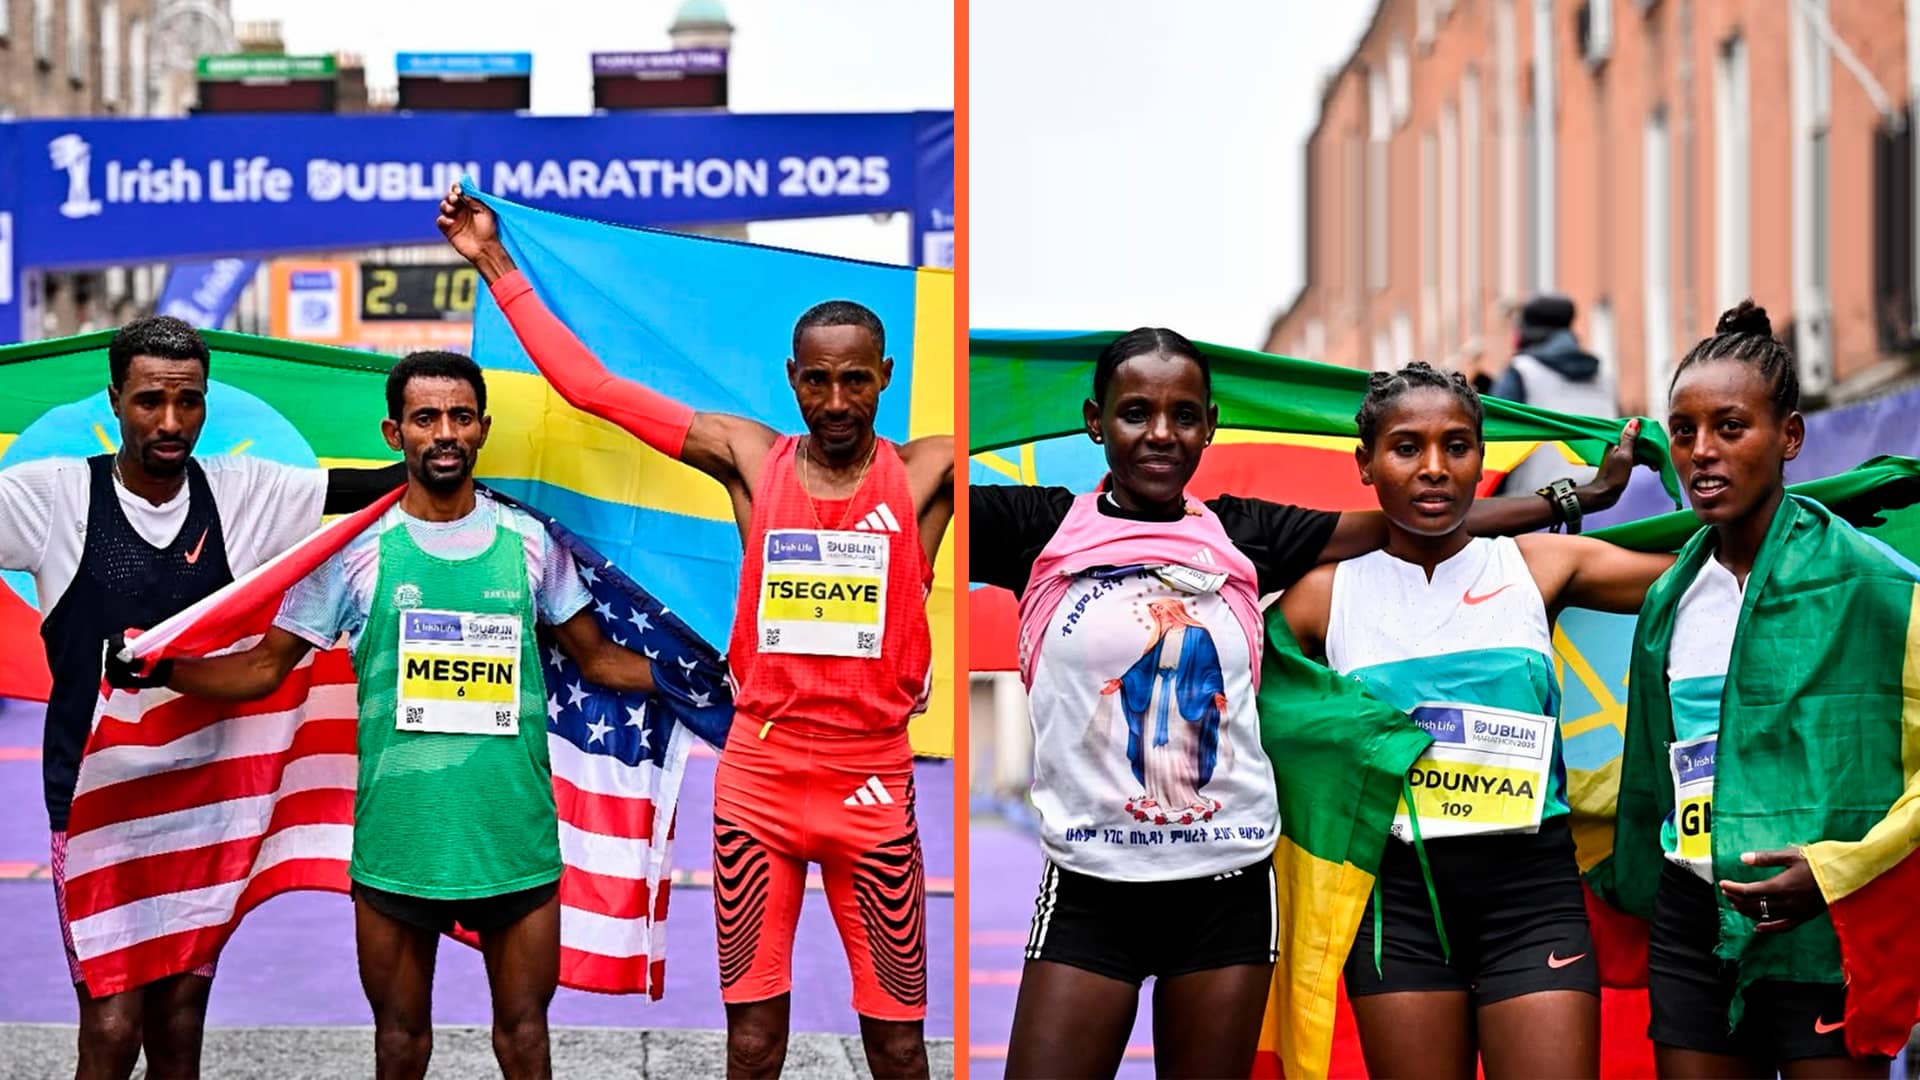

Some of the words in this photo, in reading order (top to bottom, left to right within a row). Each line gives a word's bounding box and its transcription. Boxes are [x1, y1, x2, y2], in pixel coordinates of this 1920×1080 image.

[106, 157, 201, 202] Irish
[209, 156, 293, 202] Life
[307, 158, 481, 201] DUBLIN
[493, 158, 768, 199] MARATHON
[778, 156, 890, 197] 2025
[827, 541, 876, 554] DUBLIN
[768, 580, 878, 603] TSEGAYE
[815, 606, 823, 618] 3
[406, 658, 513, 684] MESFIN
[457, 686, 466, 697] 6
[1437, 720, 1456, 732] Life
[1474, 720, 1536, 740] DUBLIN
[1473, 735, 1517, 747] MARATHON
[1517, 740, 1536, 749] 2025
[1694, 756, 1710, 767] Irish
[1441, 802, 1473, 817] 109
[1066, 827, 1097, 842] ሁሉም
[1103, 829, 1124, 845] ነገር
